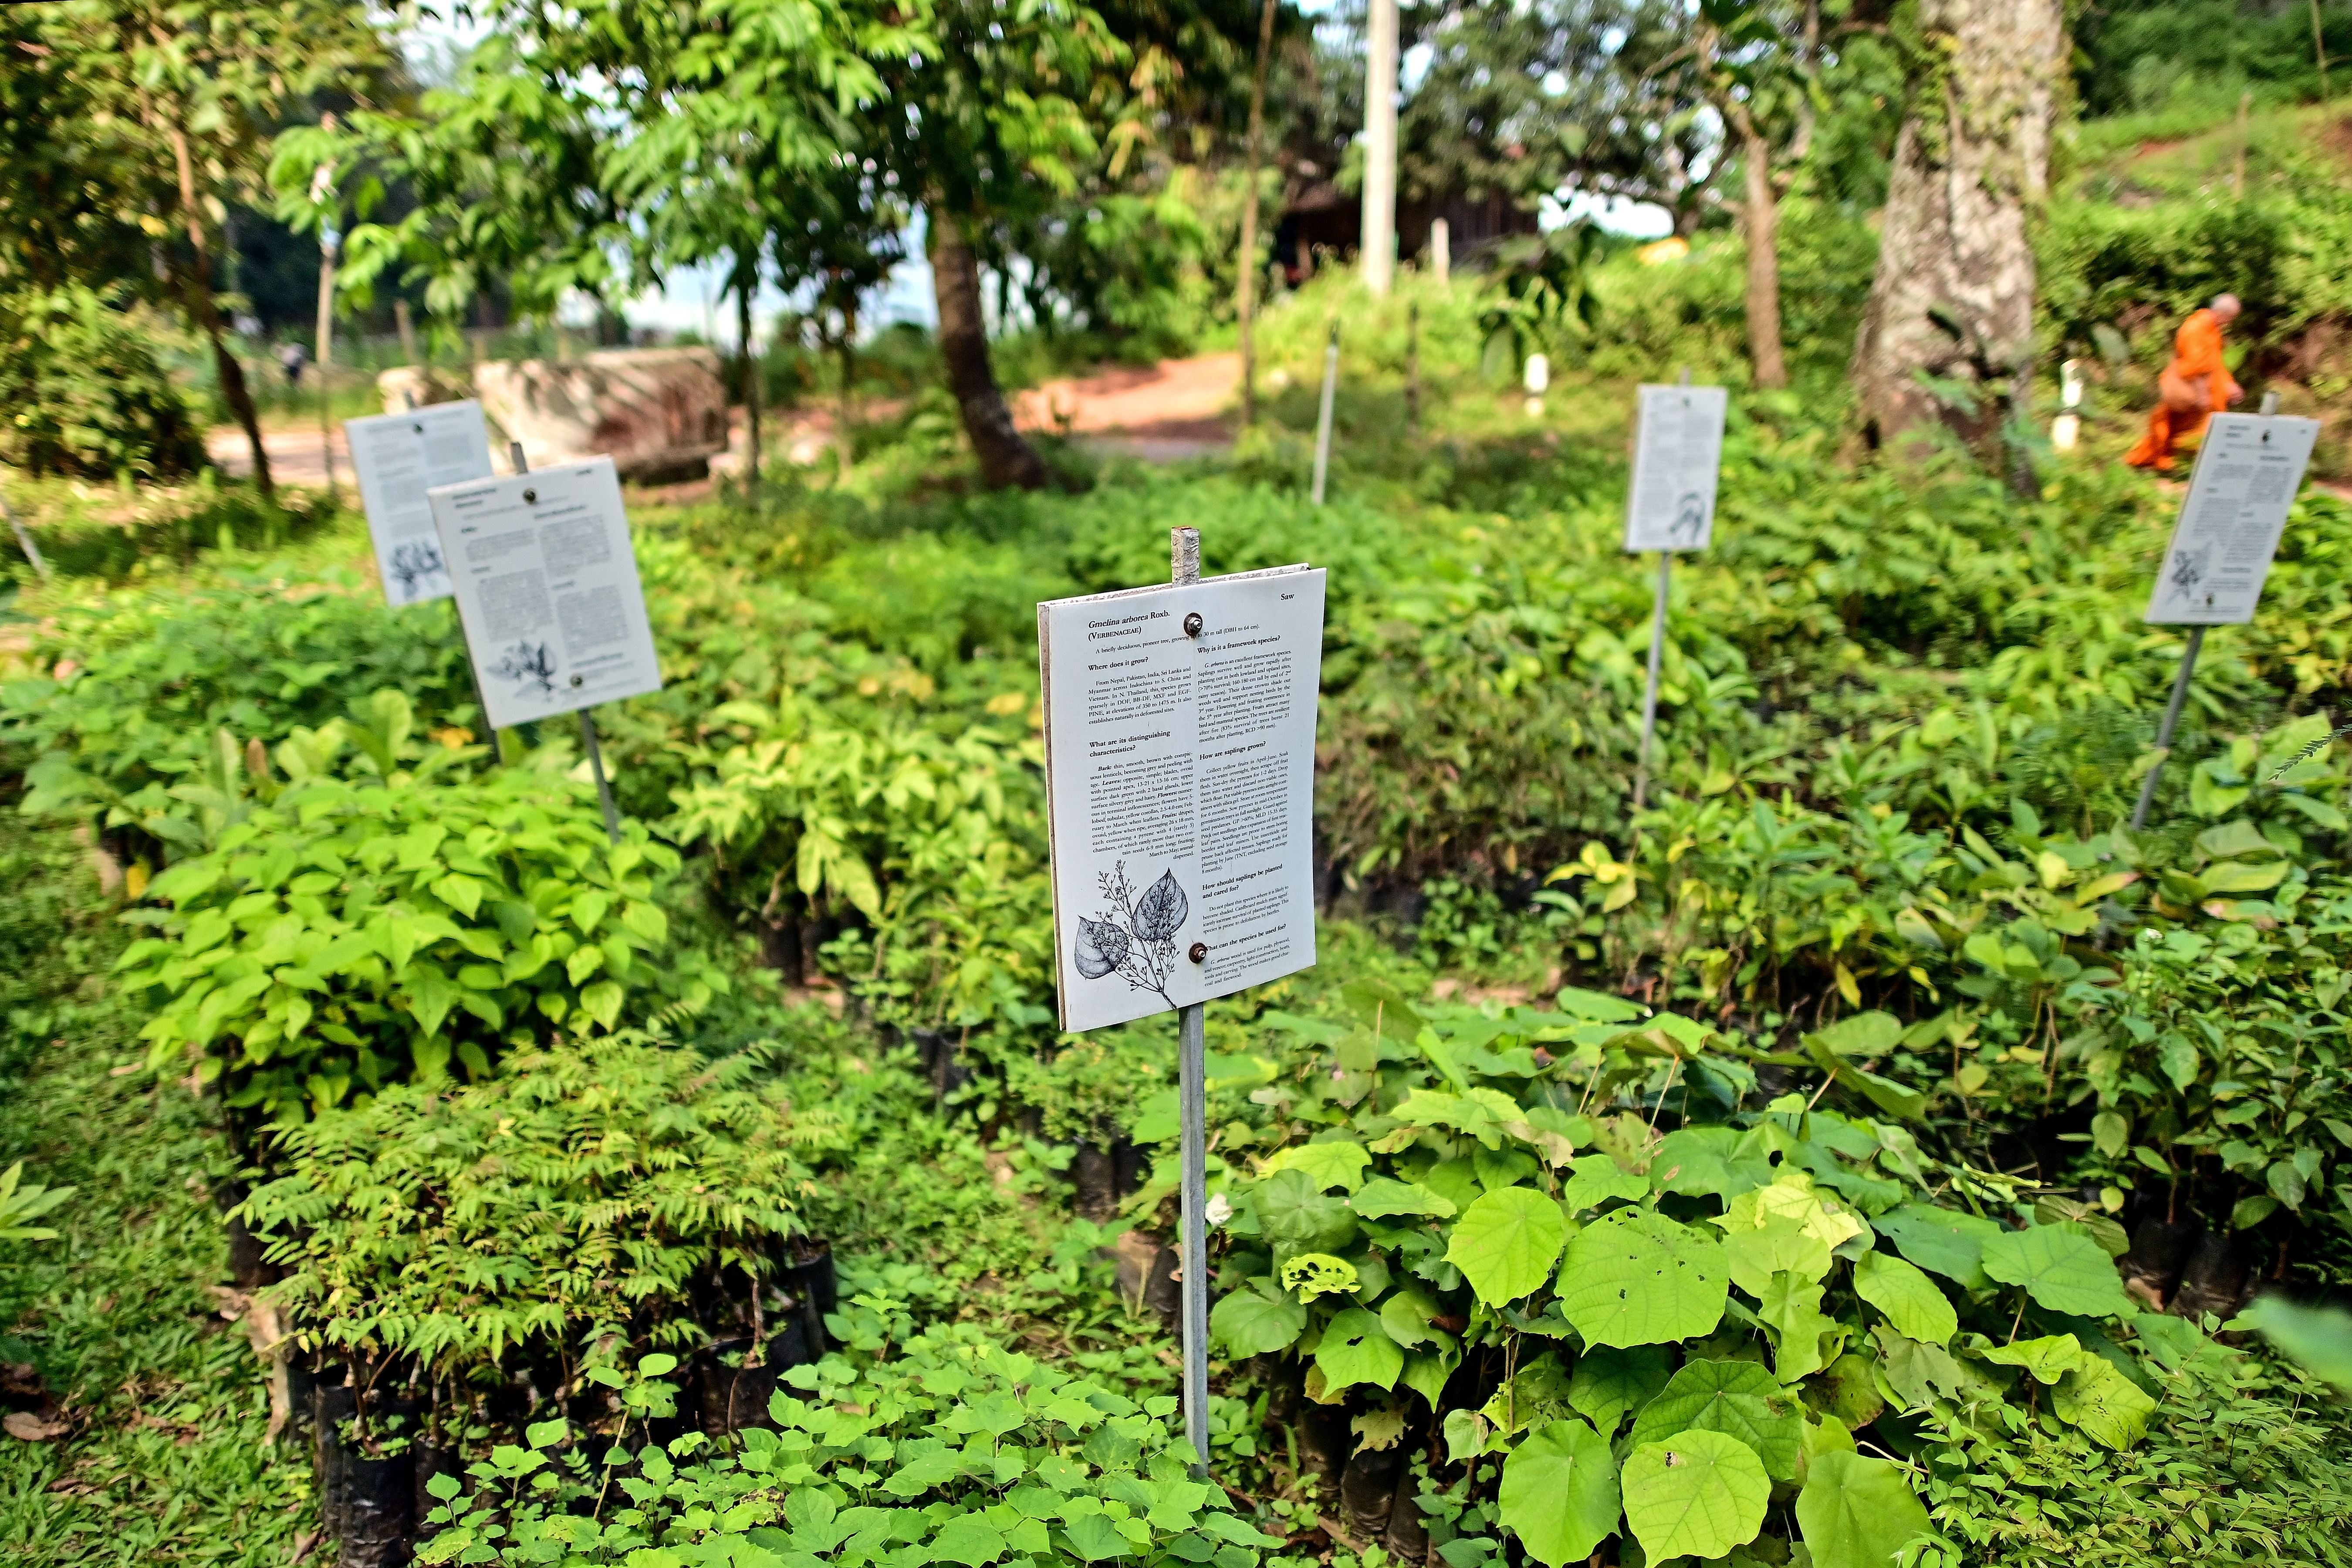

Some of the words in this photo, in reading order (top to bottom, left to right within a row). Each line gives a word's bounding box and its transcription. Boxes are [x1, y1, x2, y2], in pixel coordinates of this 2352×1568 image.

[1088, 618, 1120, 629] Gmelina
[1122, 615, 1148, 624] arborea
[1150, 610, 1170, 619] Roxb.
[1227, 639, 1257, 649] framework
[1258, 635, 1281, 645] species?
[1131, 656, 1149, 666] grow?
[1198, 677, 1215, 686] planting
[1266, 665, 1280, 673] upland
[1160, 684, 1176, 692] species
[1088, 702, 1108, 711] sparsely
[1140, 708, 1163, 716] deforested
[1128, 730, 1170, 742] distinguishing
[1089, 744, 1136, 757] characteristics?
[1224, 747, 1246, 756] saplings
[1247, 740, 1266, 752] grown?
[1123, 775, 1144, 783] opposite,
[1103, 785, 1121, 794] pointed
[1173, 824, 1188, 832] (rarely
[1217, 877, 1234, 887] should
[1236, 873, 1257, 882] saplings
[1265, 863, 1283, 875] planted
[1213, 887, 1228, 896] cared
[1239, 934, 1257, 943] species
[1265, 926, 1277, 935] used
